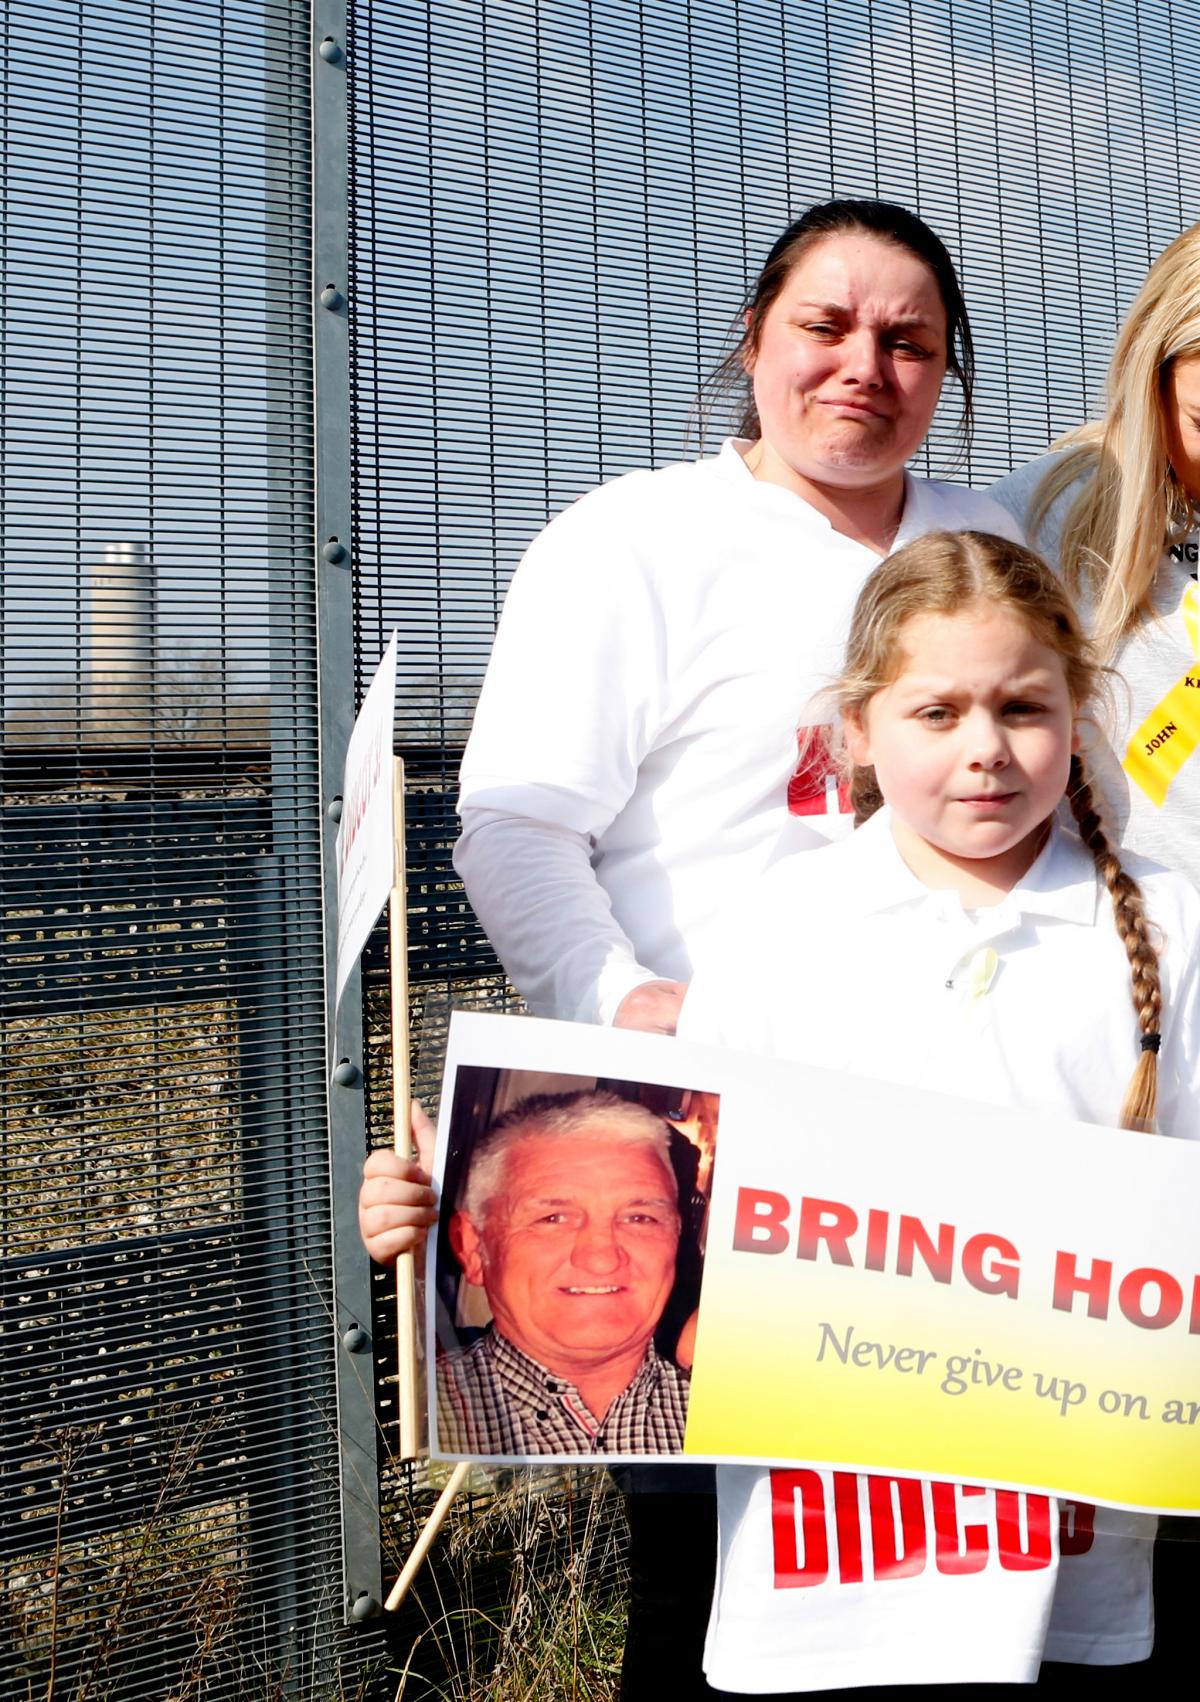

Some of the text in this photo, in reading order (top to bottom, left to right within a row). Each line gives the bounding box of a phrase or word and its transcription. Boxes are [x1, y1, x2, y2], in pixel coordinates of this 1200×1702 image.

[1168, 543, 1198, 563] NG
[1144, 721, 1178, 756] JOHN
[732, 1186, 1021, 1300] BRING
[815, 1322, 937, 1374] Never
[940, 1347, 1023, 1396] give
[1032, 1373, 1087, 1417] up
[1099, 1387, 1151, 1421] on
